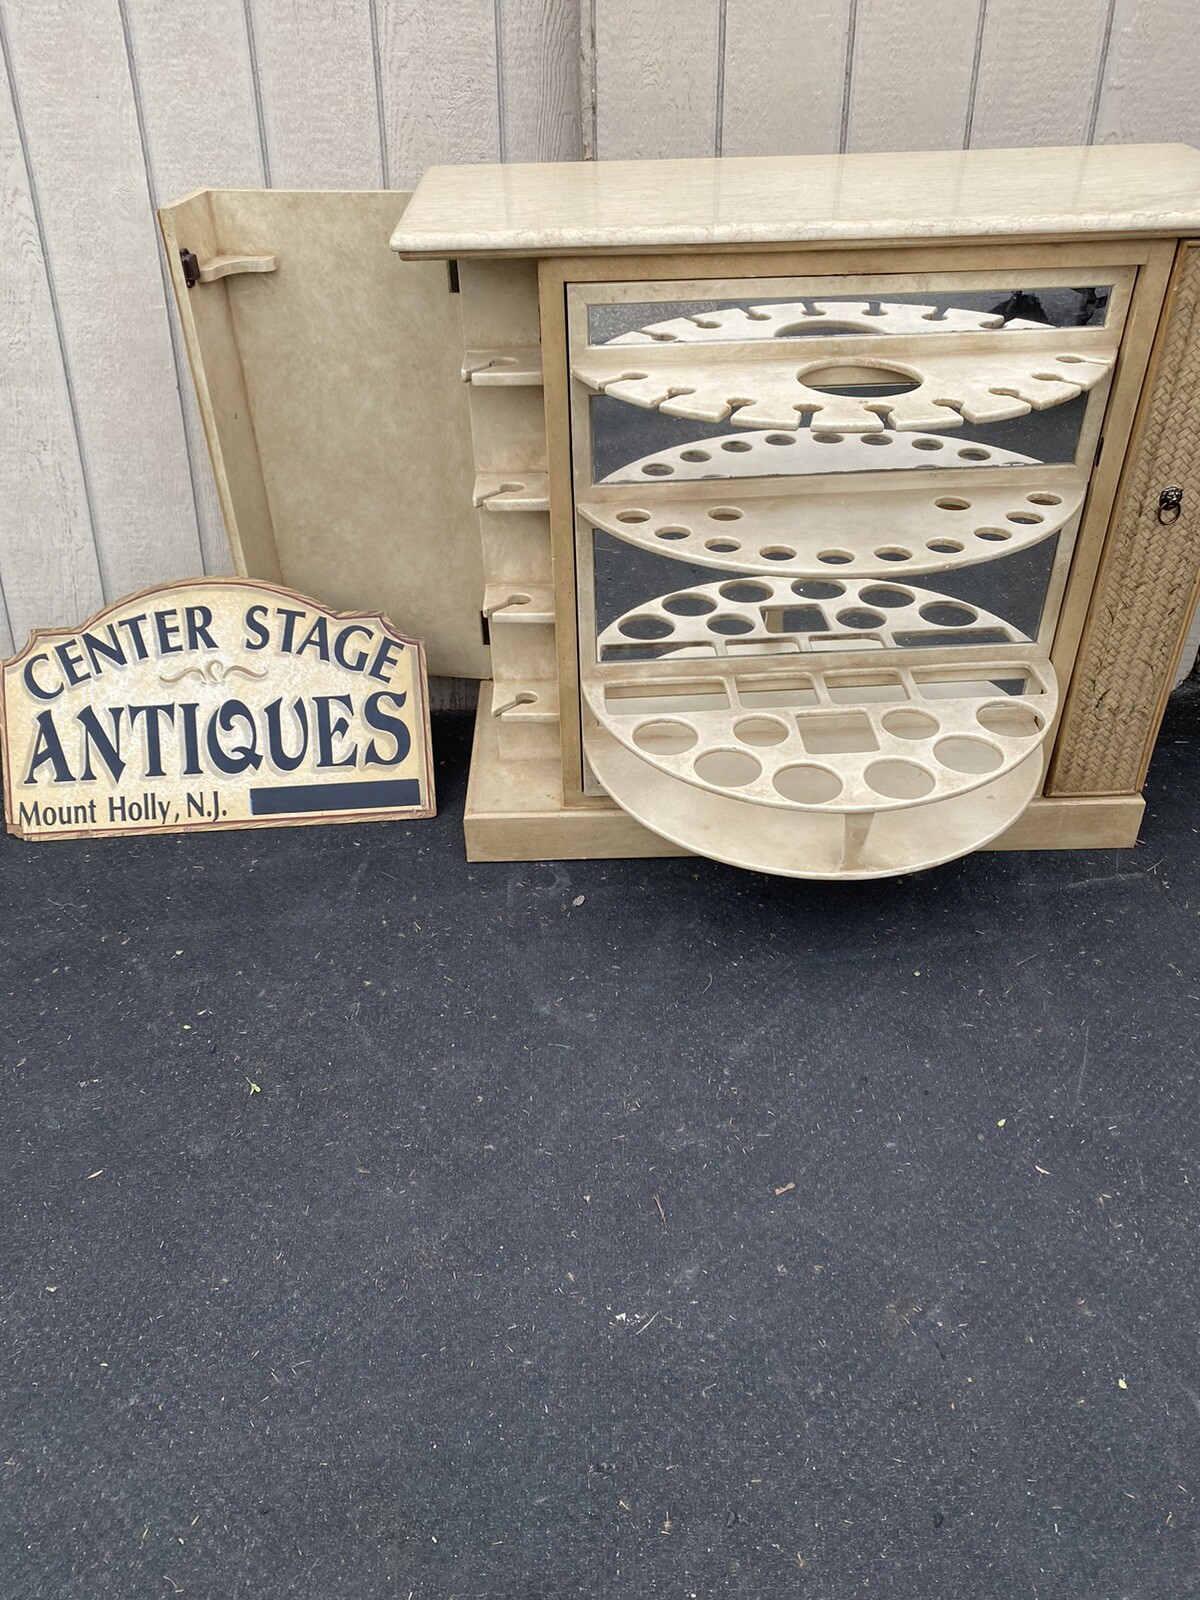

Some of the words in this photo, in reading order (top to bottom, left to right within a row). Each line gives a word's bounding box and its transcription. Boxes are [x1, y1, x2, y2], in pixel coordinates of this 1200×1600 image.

[23, 605, 219, 700] CENTER
[245, 605, 405, 684] STAGE
[23, 690, 411, 784] ANTIQUES
[19, 799, 97, 826] Mount
[108, 793, 180, 825] Holly,
[186, 791, 227, 822] N.J.
